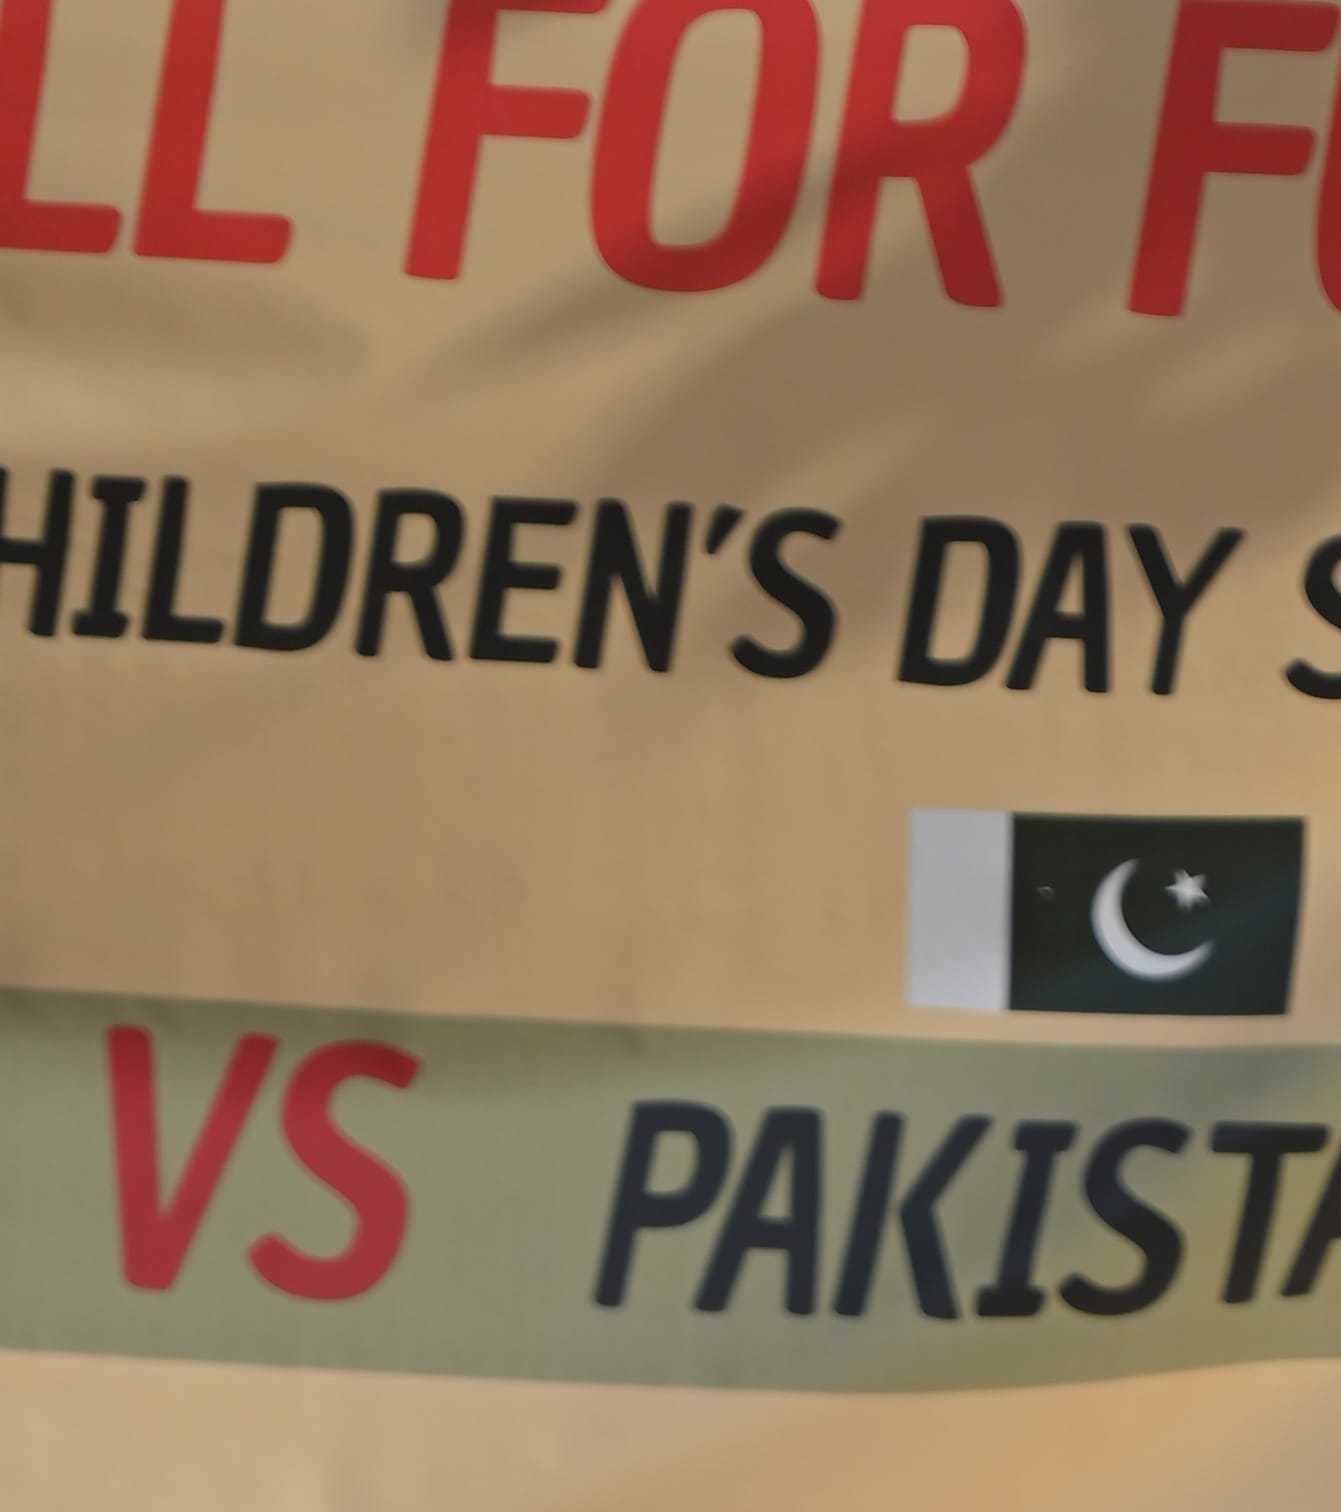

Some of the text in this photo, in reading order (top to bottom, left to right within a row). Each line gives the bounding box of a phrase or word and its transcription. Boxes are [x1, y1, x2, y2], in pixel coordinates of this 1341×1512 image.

[402, 0, 1029, 310] FOR
[896, 514, 1246, 697] DAY
[105, 1024, 421, 1300] VS
